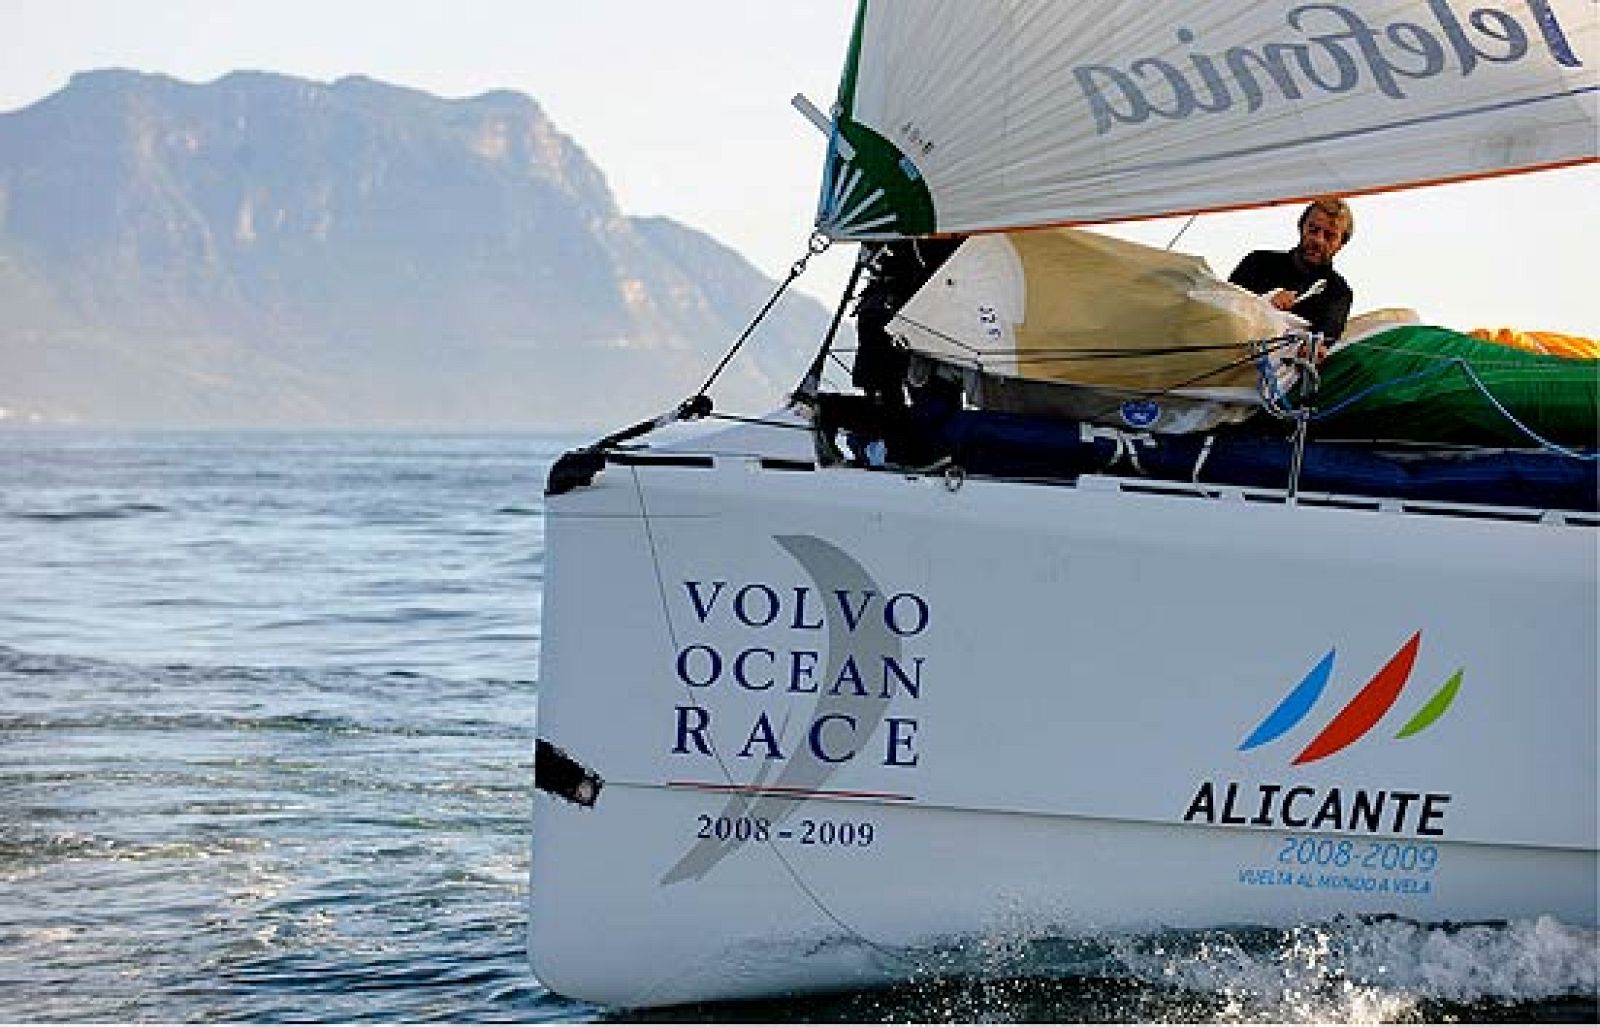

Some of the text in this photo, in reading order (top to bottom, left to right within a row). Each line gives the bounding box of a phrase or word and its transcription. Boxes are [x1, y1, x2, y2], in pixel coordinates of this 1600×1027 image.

[683, 581, 930, 637] VOLVO
[676, 644, 926, 699] OCEAN
[671, 704, 920, 767] RACE
[1183, 781, 1453, 836] ALICANTE
[1279, 837, 1439, 872] 2008-2009
